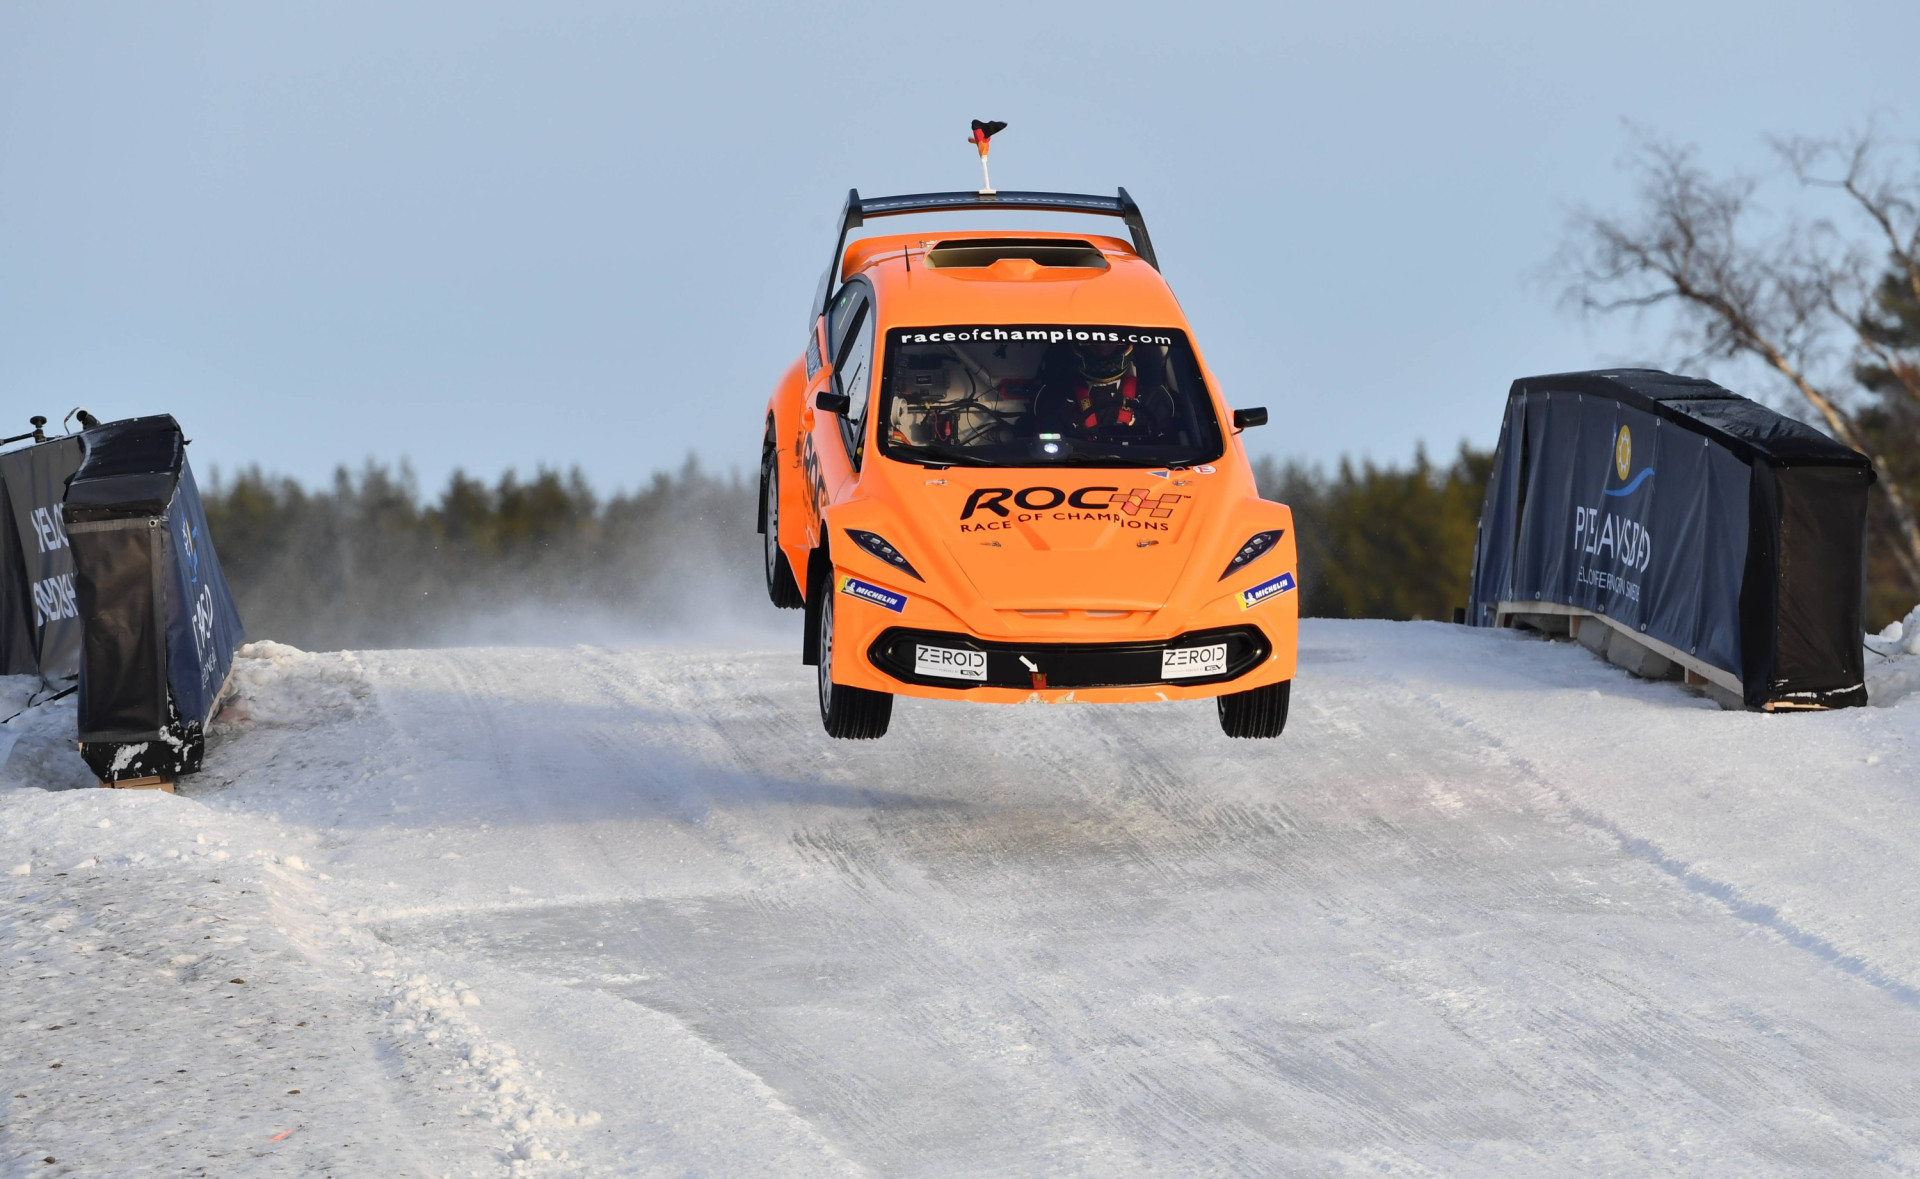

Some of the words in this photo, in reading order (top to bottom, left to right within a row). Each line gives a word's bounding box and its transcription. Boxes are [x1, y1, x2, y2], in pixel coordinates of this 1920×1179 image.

[901, 328, 1171, 346] raceofchampions.com
[960, 486, 1119, 521] ROC
[961, 520, 1012, 533] RACE
[1018, 513, 1043, 523] OF
[1053, 512, 1169, 531] CHAMPIONS
[856, 586, 898, 605] MICHELIN
[1255, 578, 1288, 599] MICHELIN
[917, 646, 985, 667] ZEROID
[1164, 647, 1225, 666] ZEROID
